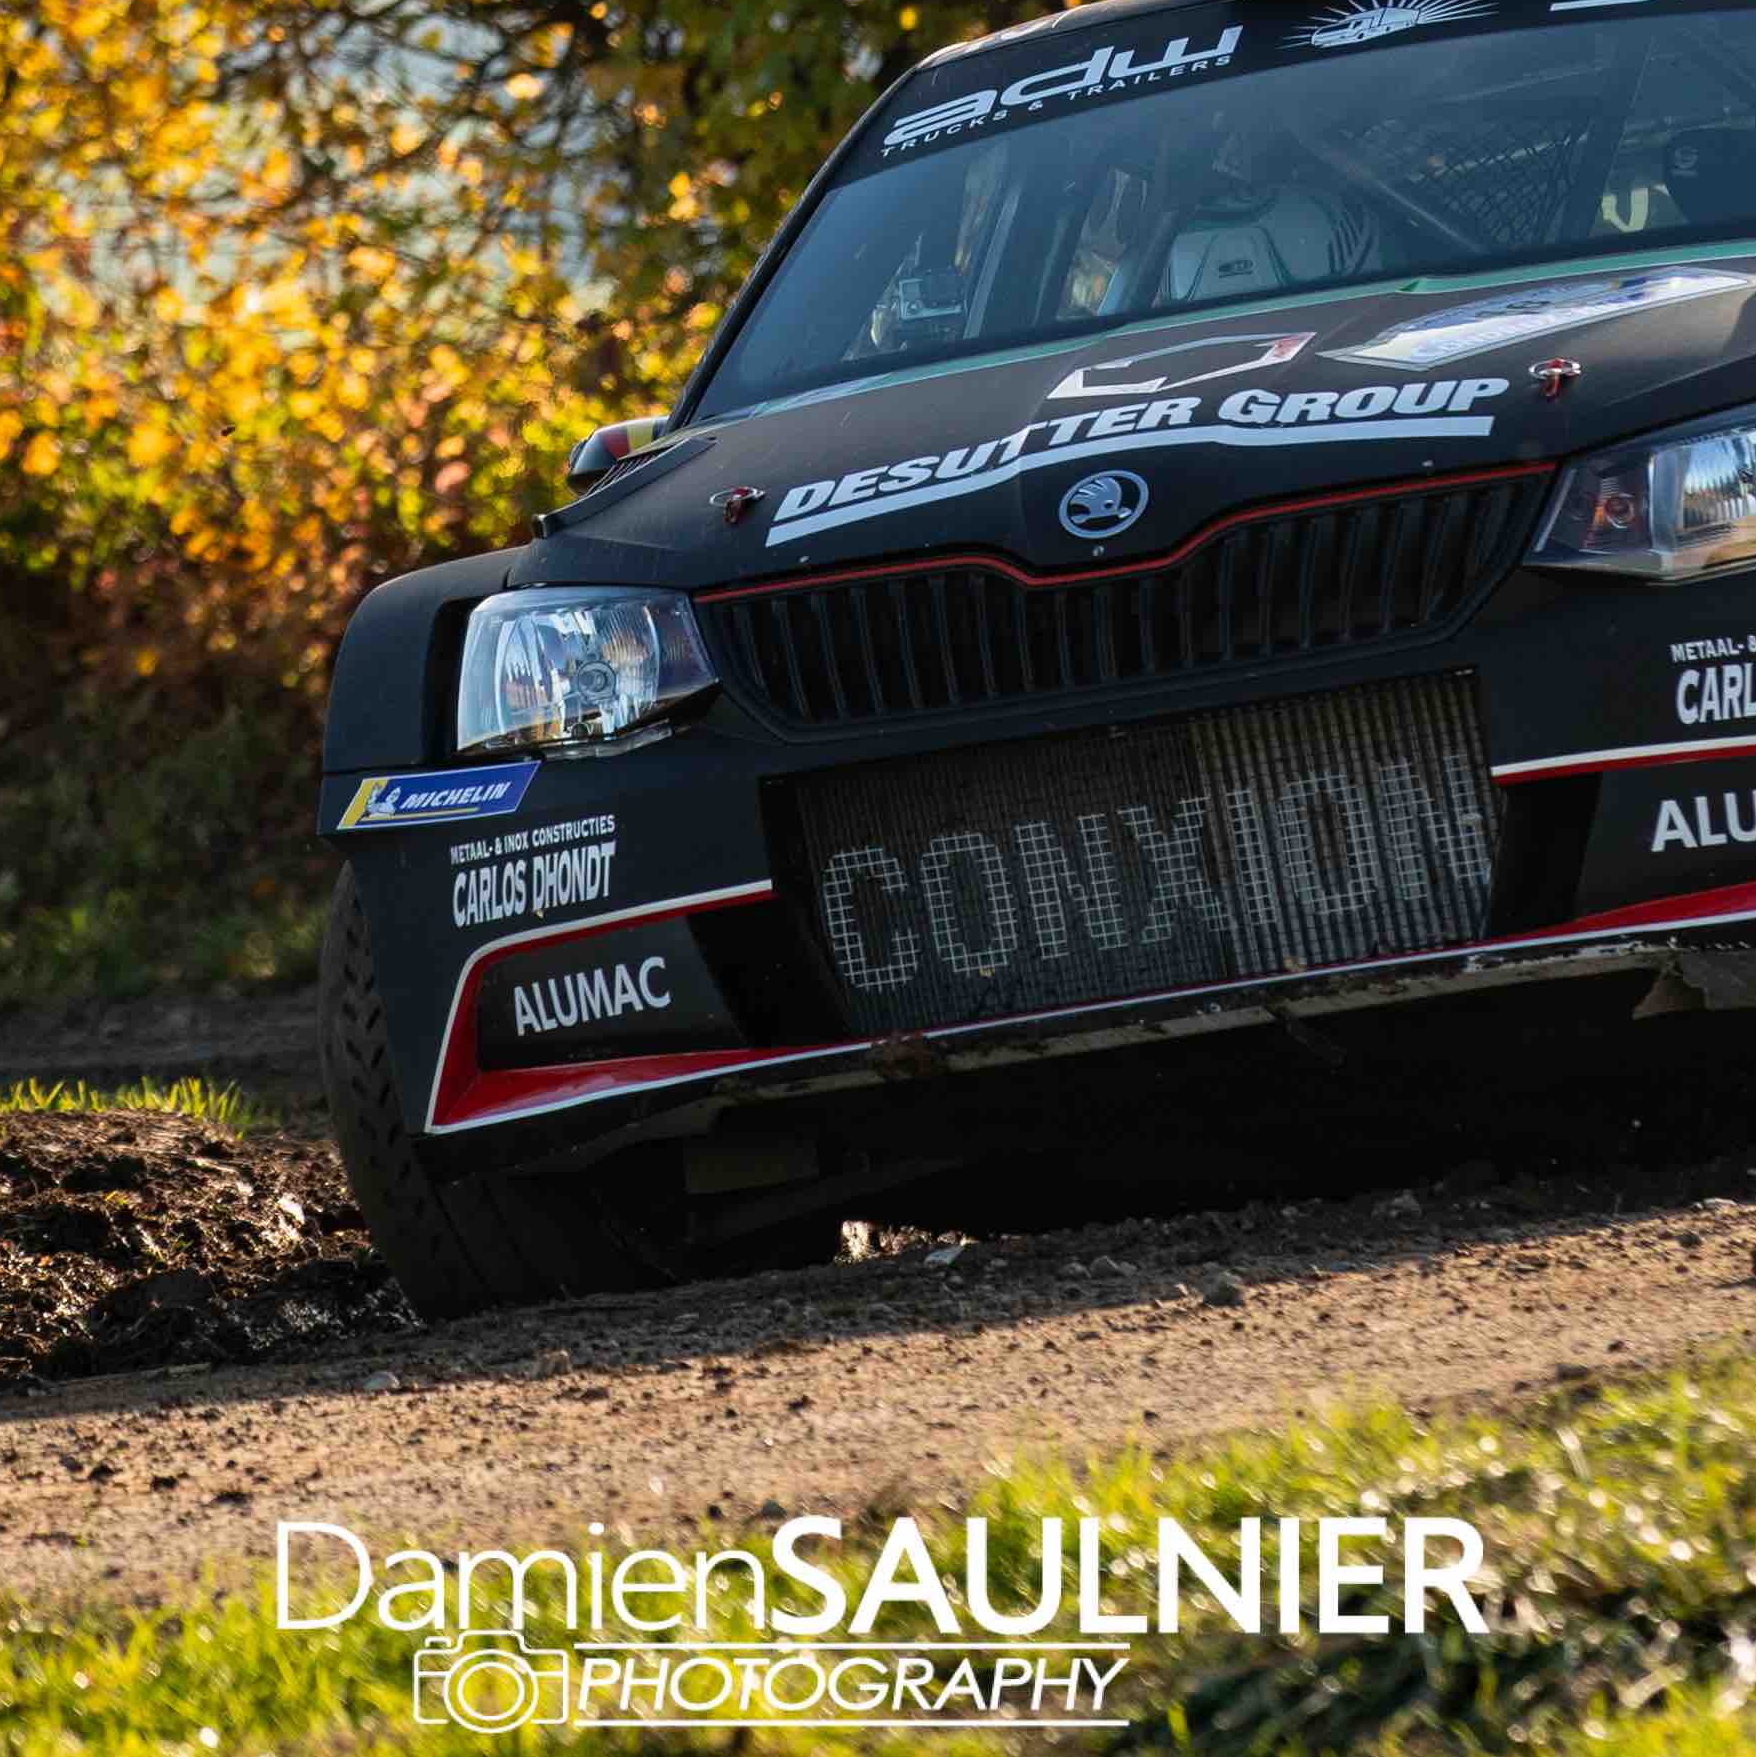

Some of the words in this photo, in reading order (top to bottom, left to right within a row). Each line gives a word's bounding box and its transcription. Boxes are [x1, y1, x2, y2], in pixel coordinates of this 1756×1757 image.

[880, 109, 1009, 158] TRUCKS
[1028, 101, 1044, 112] &
[1066, 55, 1233, 101] TRAILERS
[773, 395, 1214, 523] DESUTTER
[1218, 377, 1511, 424] GROUP
[1670, 641, 1744, 663] METAAL-
[400, 780, 513, 810] MICHELIN
[450, 843, 493, 866] METAAL-
[495, 838, 503, 855] &
[504, 831, 529, 853] INOX
[532, 814, 616, 848] CONSTRUCTIES
[822, 754, 1493, 993] CONXION
[453, 860, 526, 928] CARLOS
[532, 842, 616, 913] DHONDT
[514, 956, 671, 1037] ALUMAC
